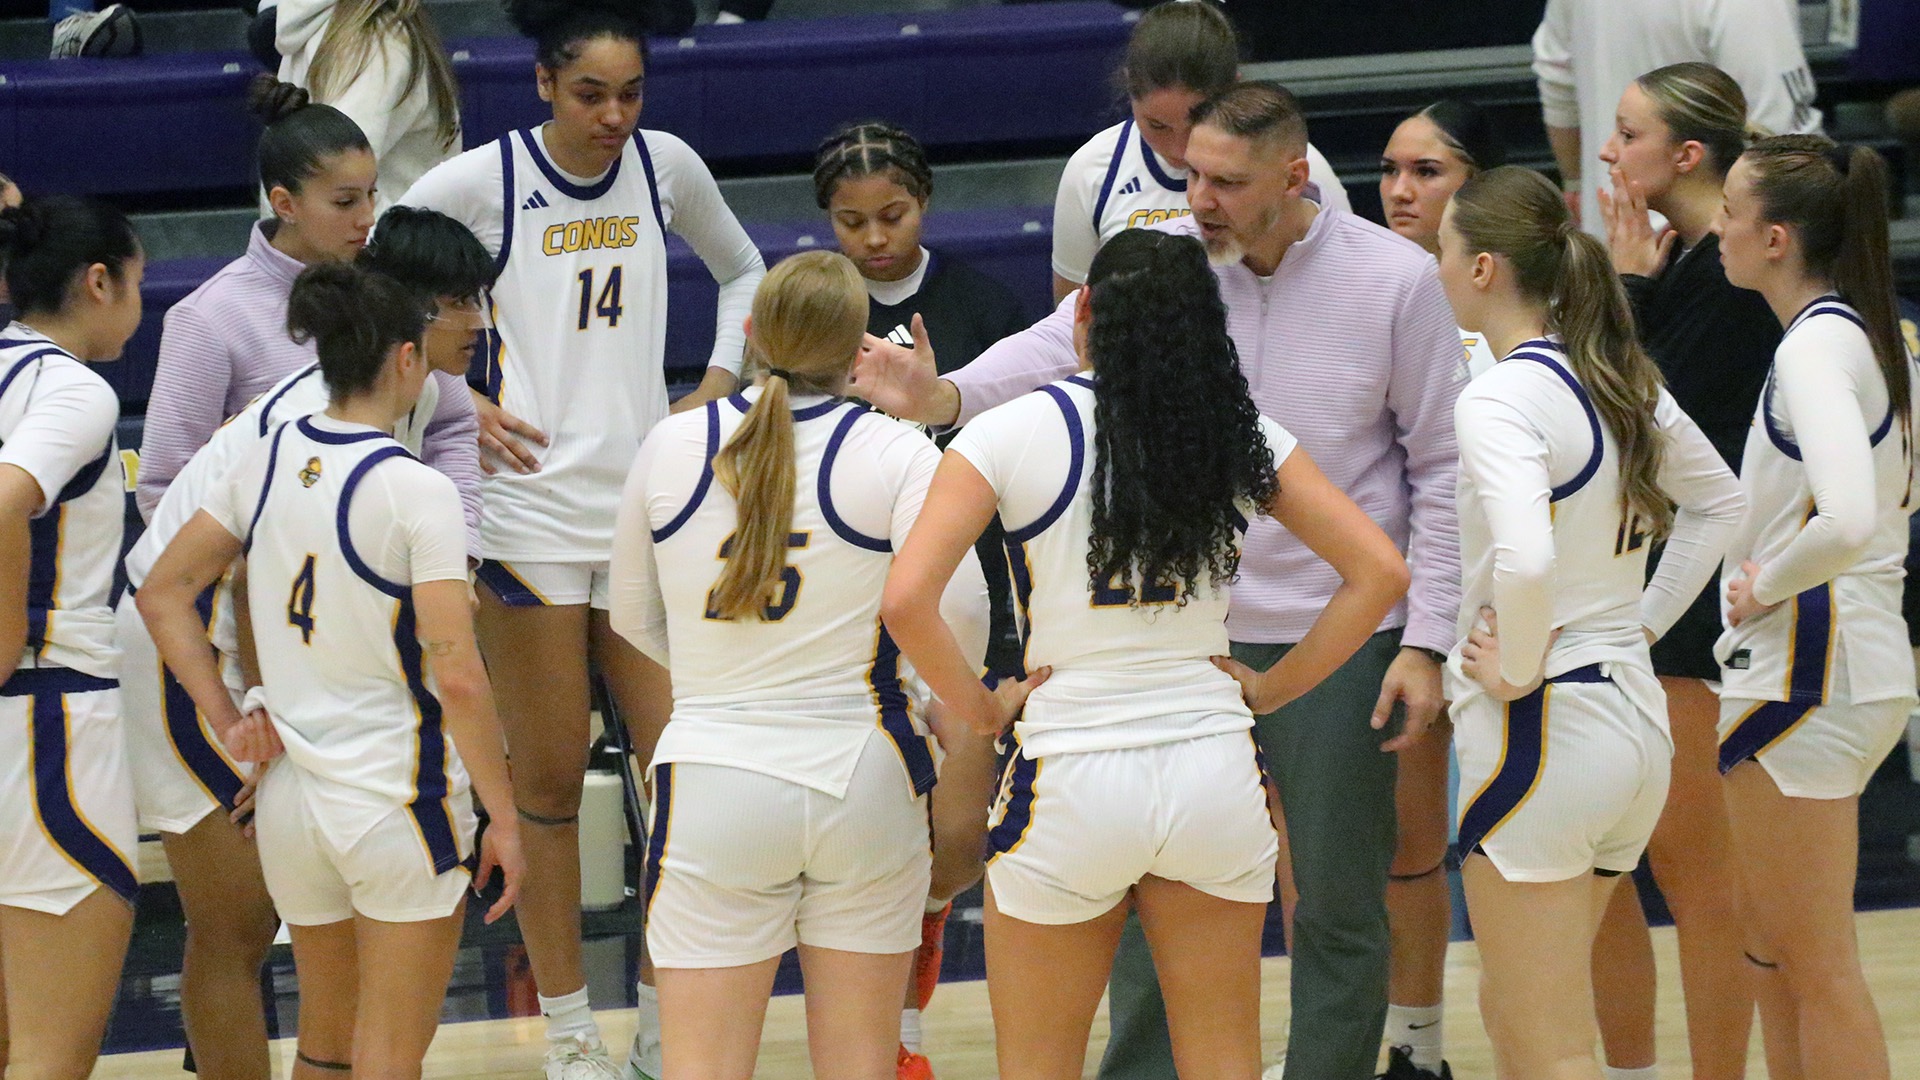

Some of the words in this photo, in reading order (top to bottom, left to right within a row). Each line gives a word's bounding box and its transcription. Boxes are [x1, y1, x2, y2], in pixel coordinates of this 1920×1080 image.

[541, 215, 640, 257] CONQS
[577, 263, 624, 332] 14
[285, 551, 319, 647] 4
[701, 528, 813, 624] 5
